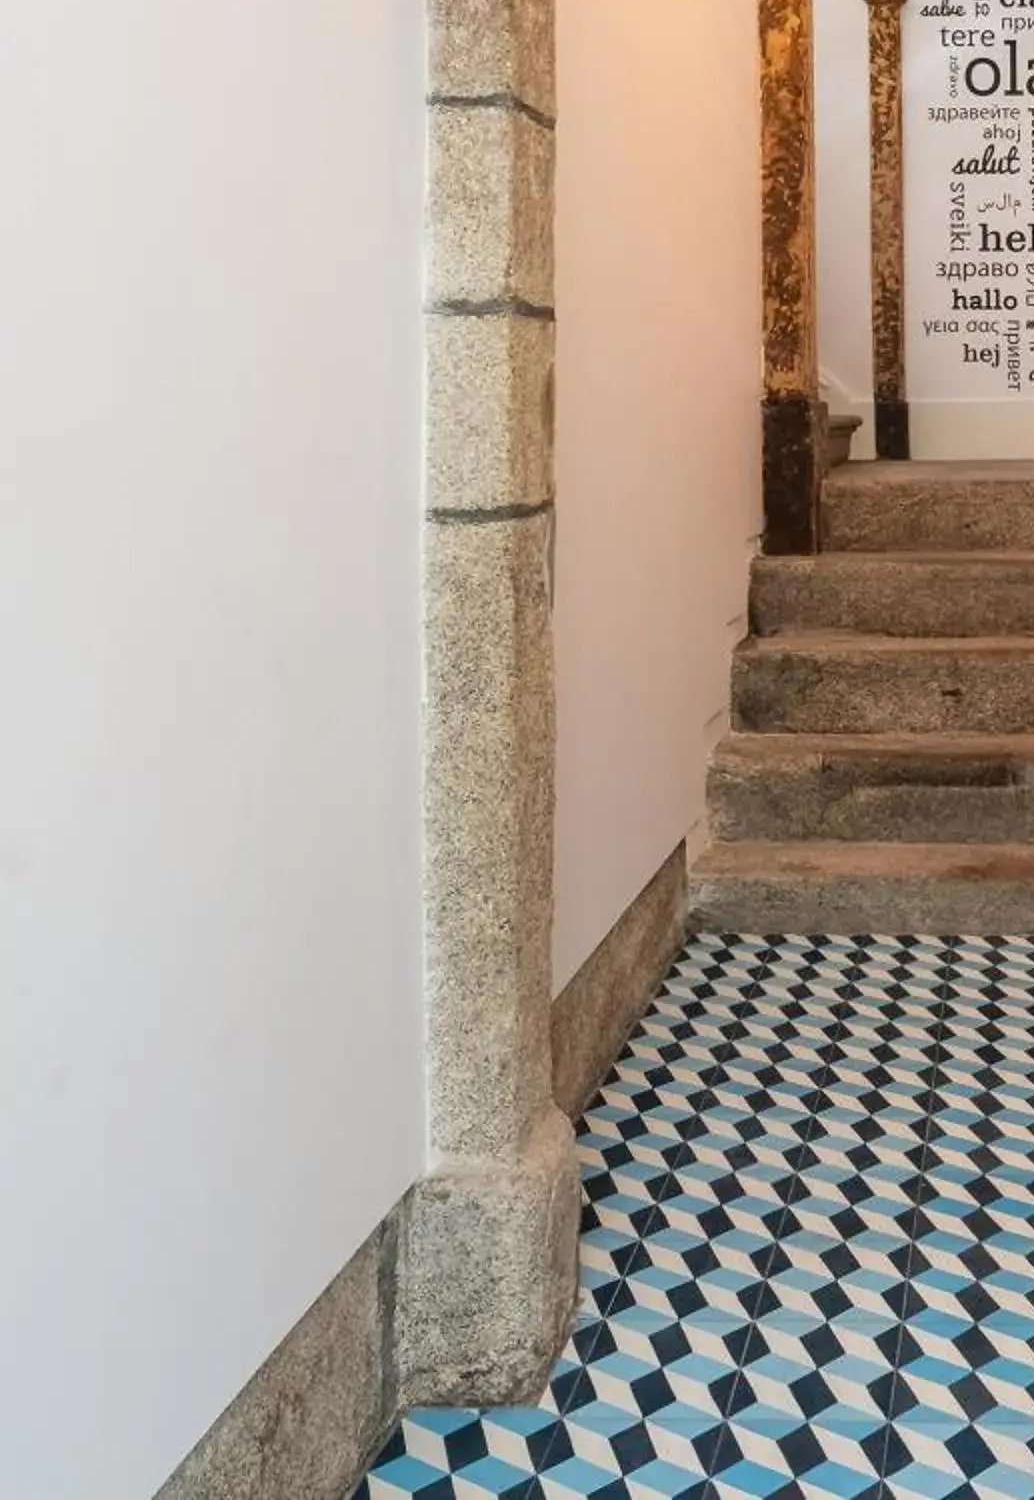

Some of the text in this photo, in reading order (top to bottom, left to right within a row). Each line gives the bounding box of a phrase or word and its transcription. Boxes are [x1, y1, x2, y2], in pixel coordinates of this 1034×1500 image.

[940, 27, 995, 47] tere
[927, 104, 1020, 123] здравейте
[982, 124, 1021, 143] ahoj
[951, 143, 1021, 175] salut
[950, 181, 971, 252] sveiki
[935, 260, 1020, 283] здраво
[951, 288, 1018, 311] hallo
[965, 319, 1001, 336] σας
[962, 343, 1000, 367] hej
[1003, 319, 1021, 392] привет
